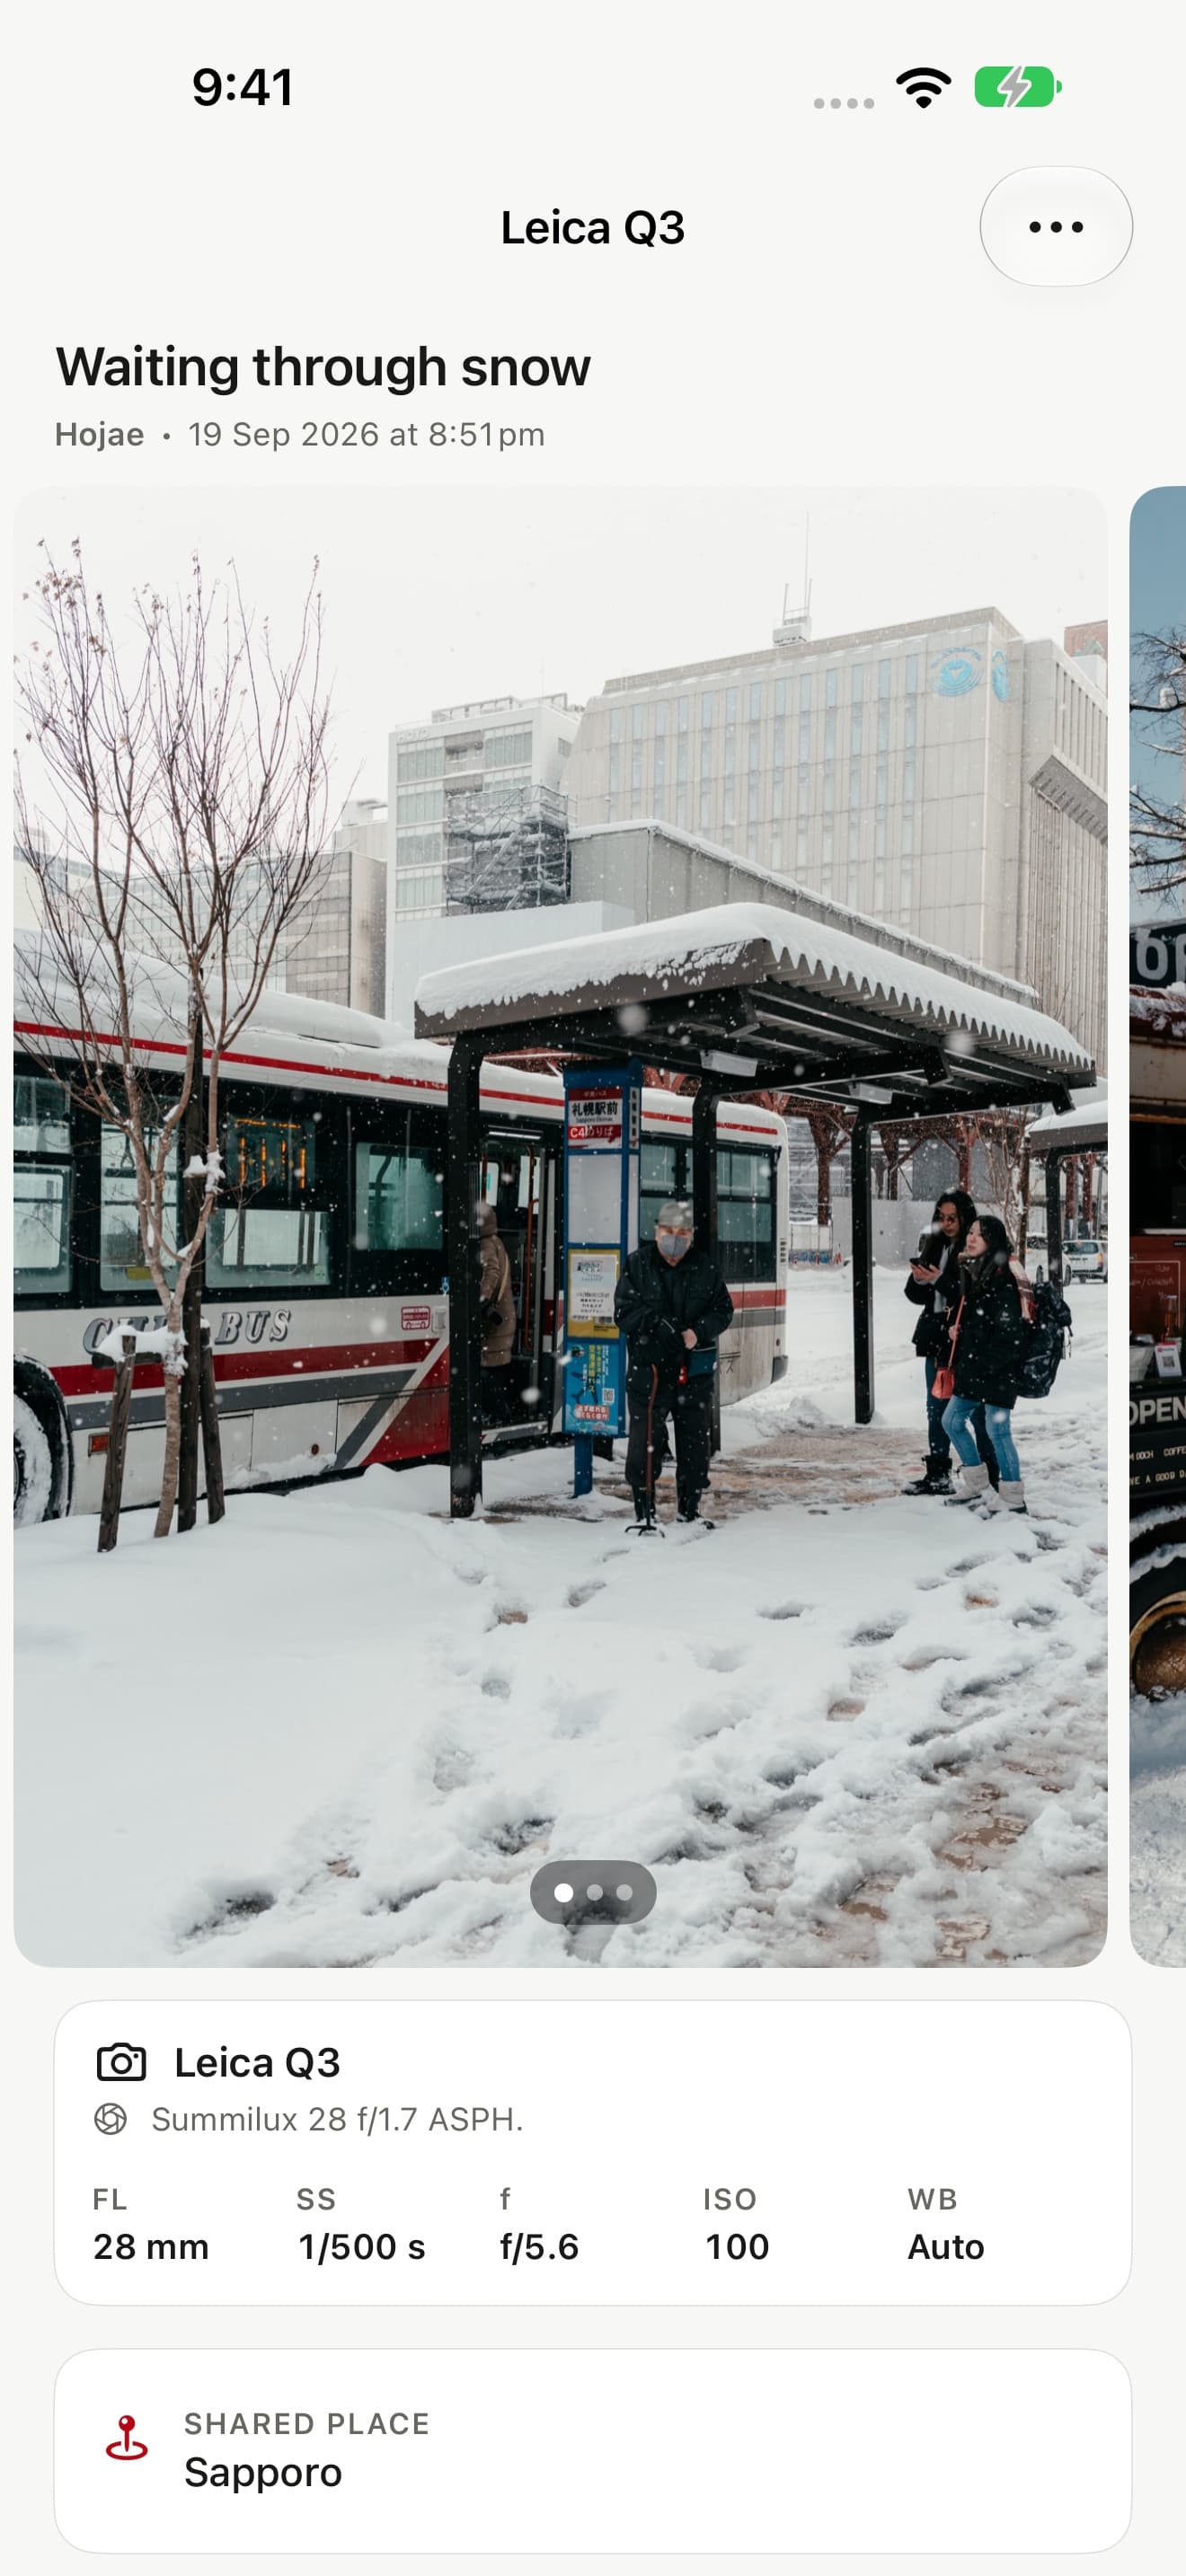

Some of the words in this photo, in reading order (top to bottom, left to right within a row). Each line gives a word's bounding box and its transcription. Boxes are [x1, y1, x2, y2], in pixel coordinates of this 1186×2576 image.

[572, 1102, 617, 1116] 札幌駅前
[215, 1309, 291, 1345] BUS
[1146, 1475, 1151, 1484] A
[1155, 1471, 1175, 1482] GOOD
